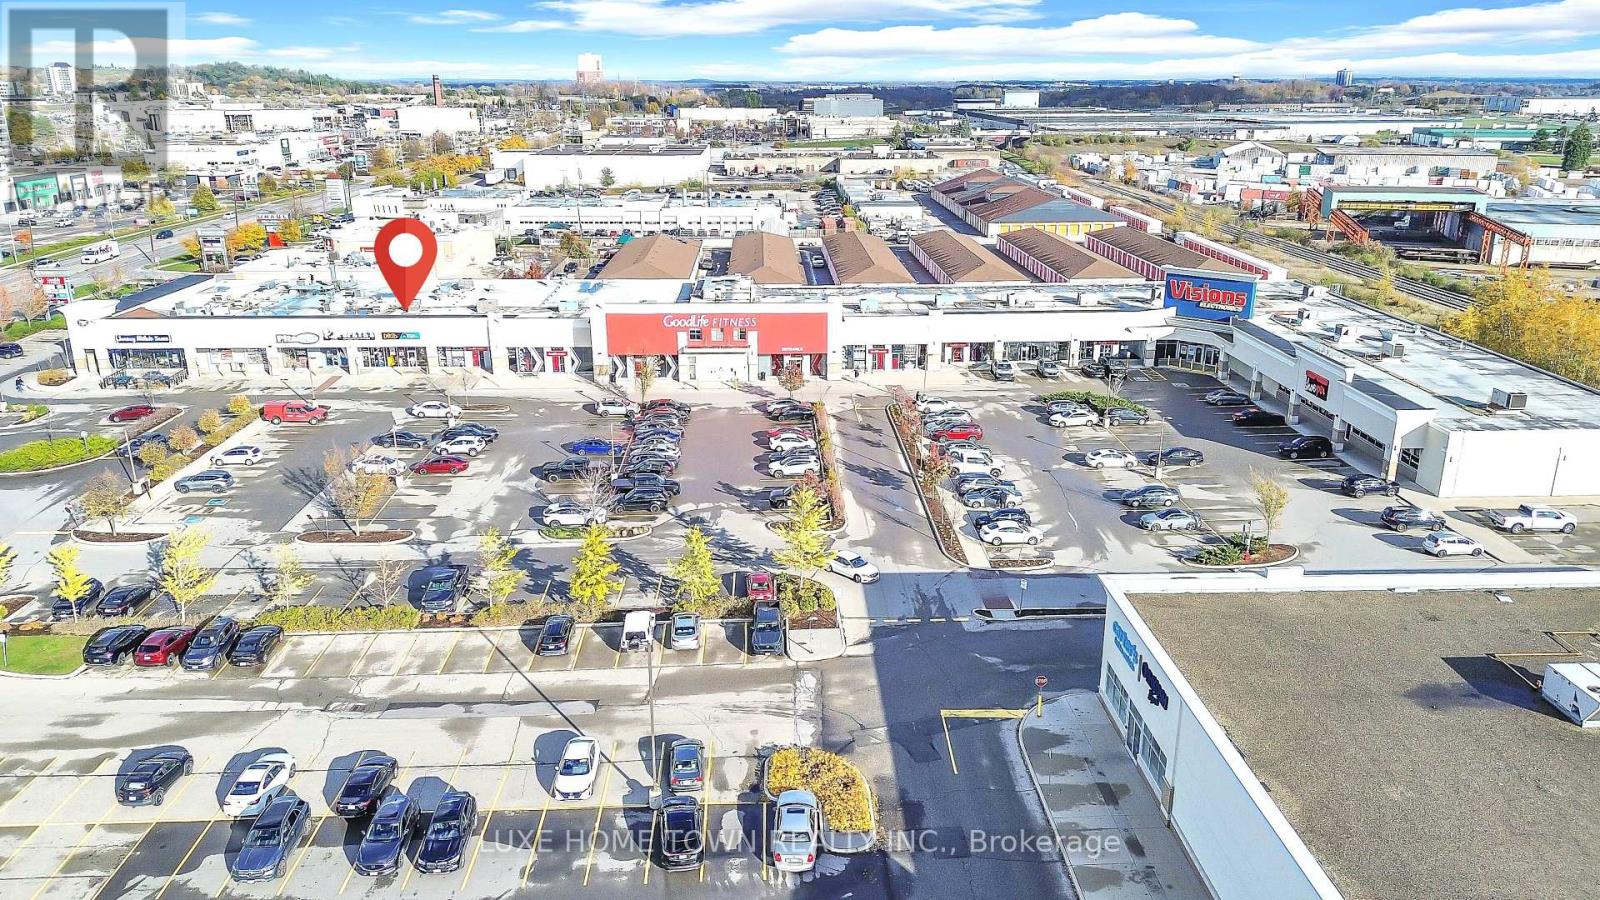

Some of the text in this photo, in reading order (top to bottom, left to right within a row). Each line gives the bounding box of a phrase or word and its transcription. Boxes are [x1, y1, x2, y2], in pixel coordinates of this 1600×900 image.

[1170, 279, 1247, 307] Visions
[663, 314, 757, 327] GoodLife FITNESS
